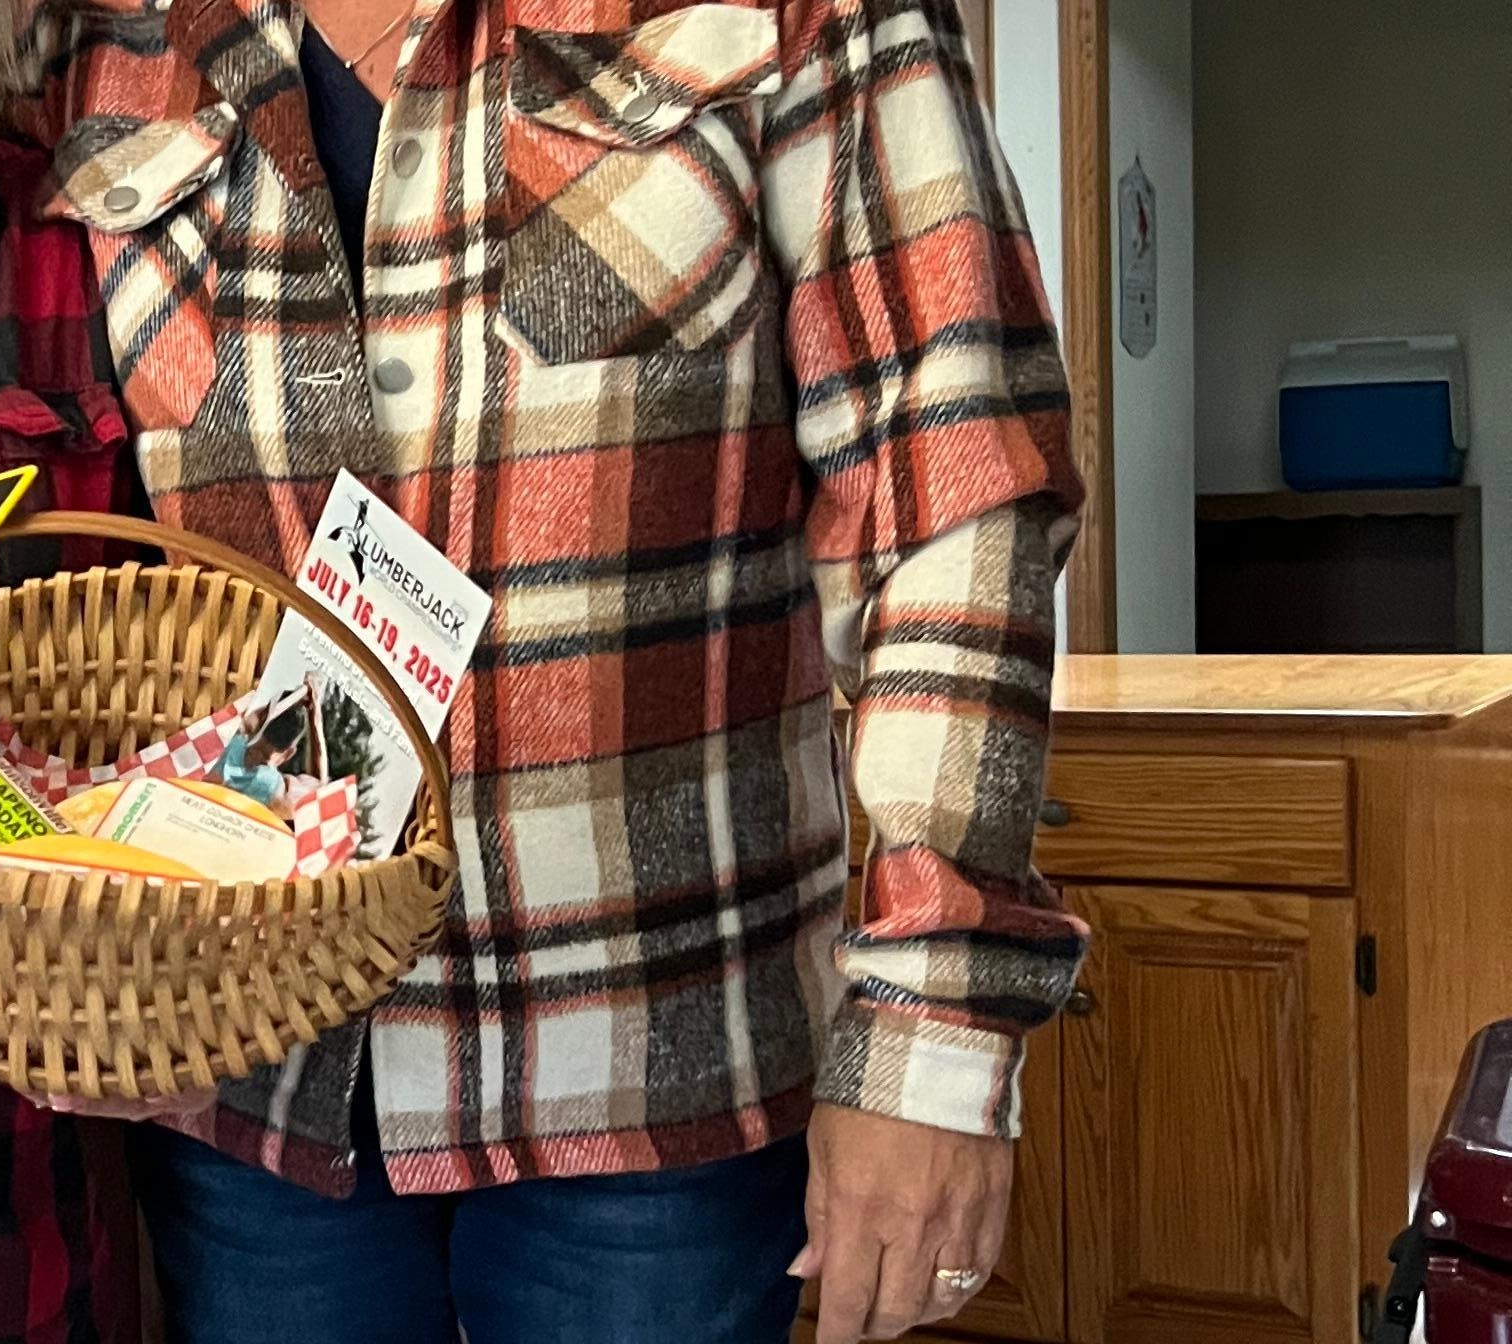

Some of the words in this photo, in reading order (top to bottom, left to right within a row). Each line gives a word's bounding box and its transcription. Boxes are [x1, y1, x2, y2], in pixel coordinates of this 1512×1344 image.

[307, 558, 351, 608] JULY
[351, 594, 398, 662] 16-19,
[404, 644, 454, 705] 2025
[360, 534, 465, 640] LUMBERJACK
